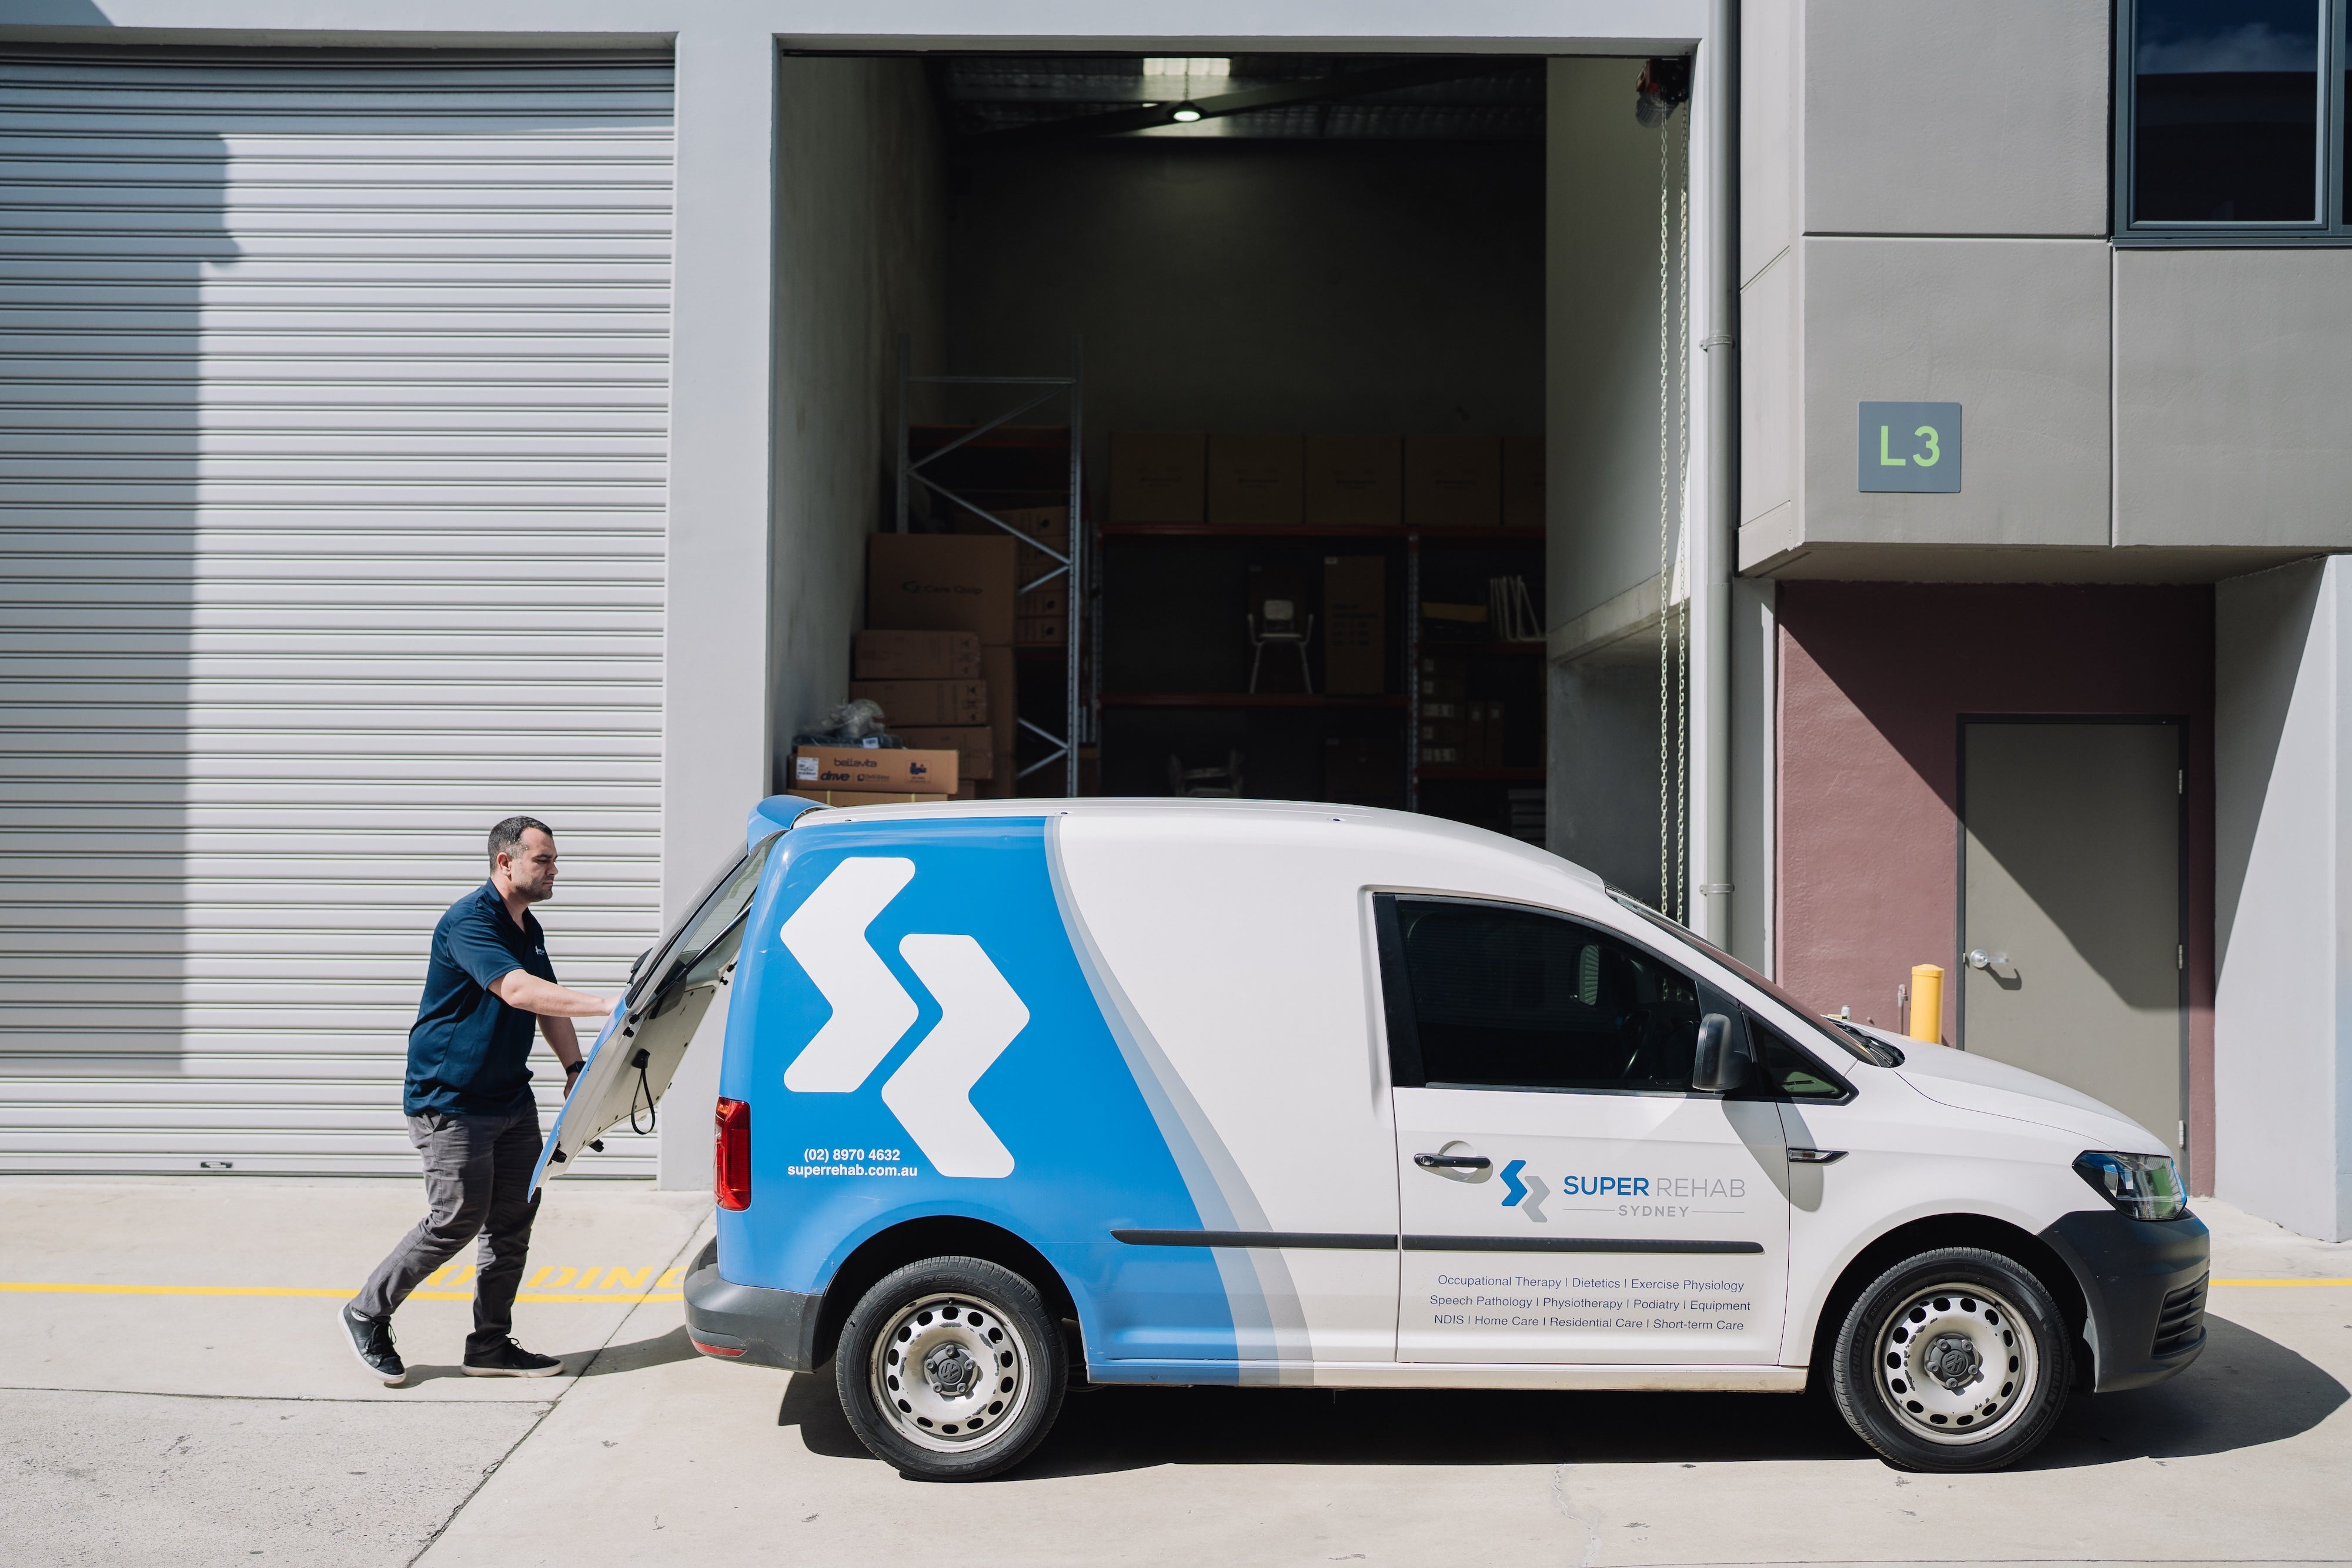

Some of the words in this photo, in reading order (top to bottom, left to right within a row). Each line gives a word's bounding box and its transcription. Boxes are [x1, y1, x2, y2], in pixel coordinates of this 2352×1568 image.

[1880, 425, 1940, 467] L3
[820, 771, 850, 781] drive
[804, 1148, 829, 1163] (02)
[833, 1149, 865, 1161] 8970
[868, 1149, 900, 1161] 4632
[787, 1164, 917, 1178] superrehab.com.au
[1563, 1175, 1650, 1196] SUPER
[1657, 1178, 1745, 1198] REHAB
[1618, 1205, 1689, 1217] SYDNEY
[425, 1265, 689, 1289] ODING
[1438, 1275, 1512, 1288] Occupational
[1515, 1276, 1562, 1289] Therapy
[1572, 1278, 1621, 1288] Dietetics
[1631, 1279, 1679, 1289] Exercise
[1683, 1279, 1745, 1293] Physiology
[1430, 1295, 1473, 1307] Speech
[1476, 1296, 1533, 1309] Pathology
[1543, 1297, 1623, 1310] Physiotherapy
[1633, 1299, 1680, 1312] Podiatry
[1690, 1300, 1751, 1312] Equipment
[1434, 1314, 1464, 1325] NDIS
[1475, 1315, 1508, 1325] Home
[1512, 1316, 1539, 1326] Care
[1550, 1317, 1612, 1328] Residential
[1615, 1318, 1643, 1328] Care
[1653, 1319, 1713, 1329] Short-term
[1716, 1320, 1744, 1330] Care
